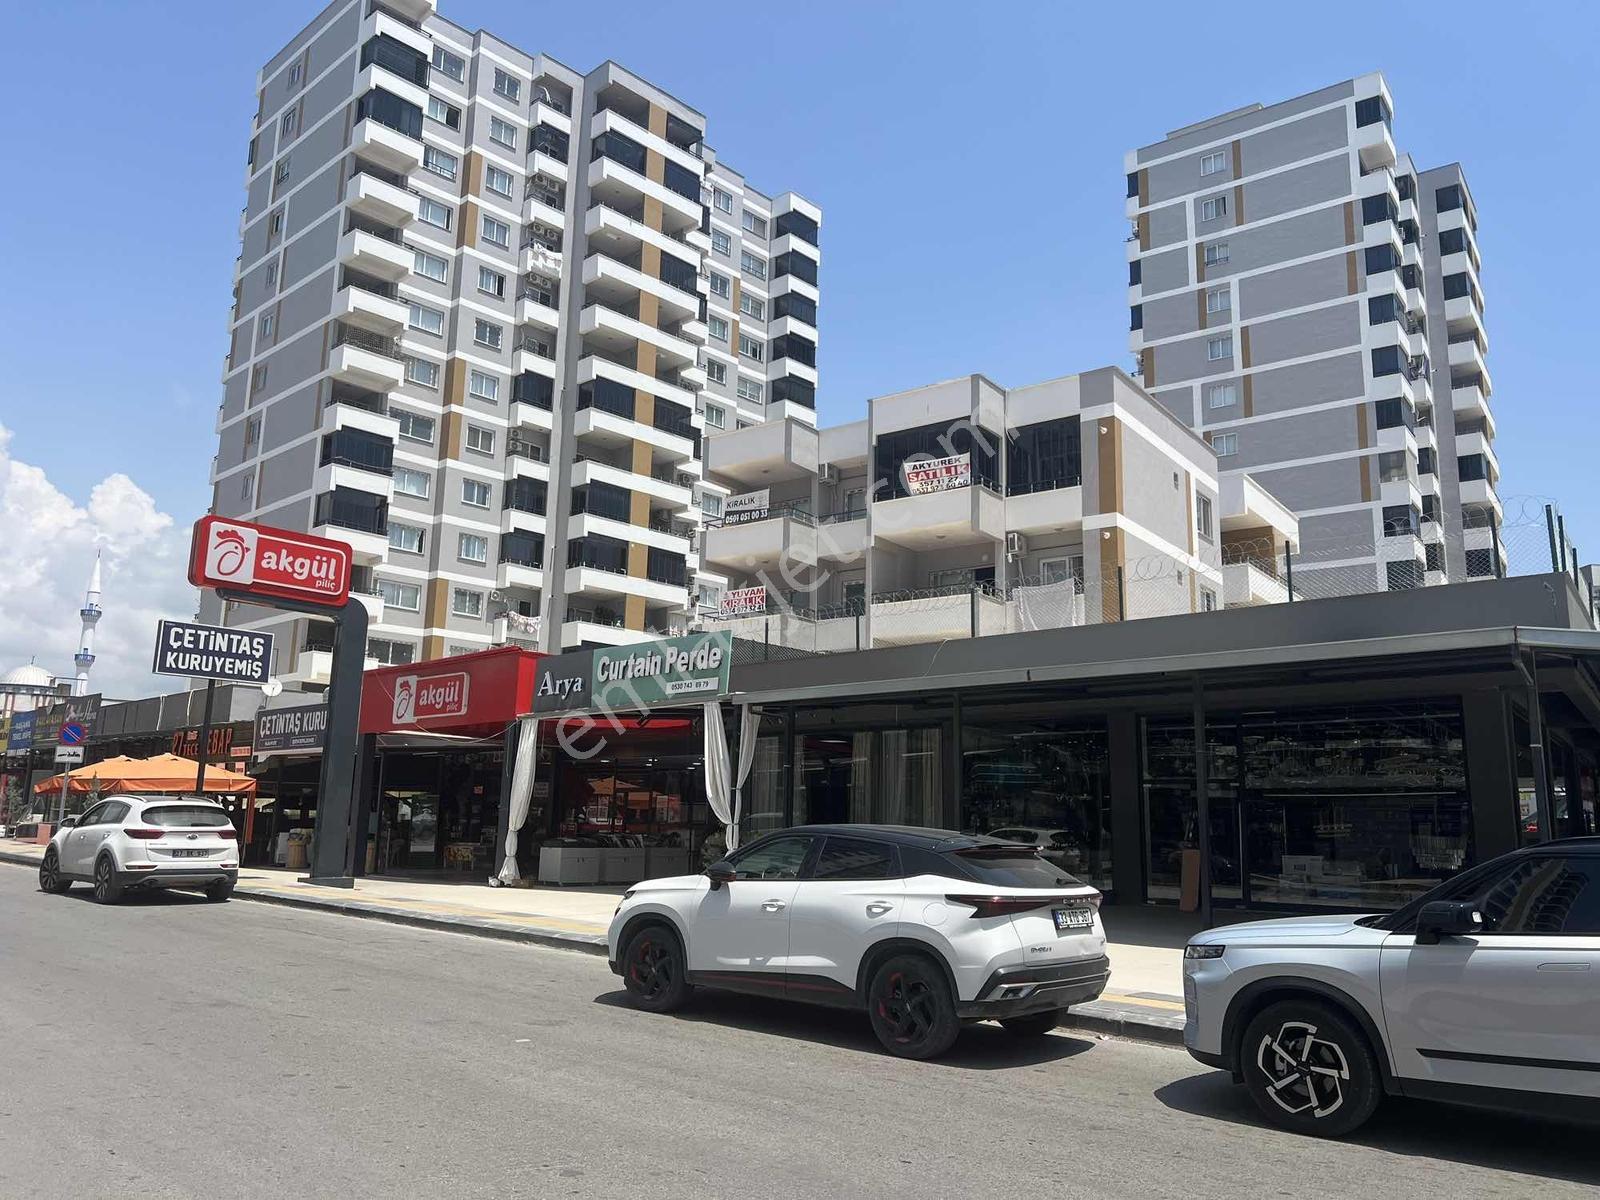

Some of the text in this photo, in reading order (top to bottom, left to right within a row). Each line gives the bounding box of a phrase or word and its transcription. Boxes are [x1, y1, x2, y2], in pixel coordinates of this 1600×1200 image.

[751, 510, 759, 519] 00
[760, 509, 768, 518] 33
[261, 549, 336, 580] akgül
[315, 578, 336, 591] piliç
[731, 587, 765, 598] YUVAM
[169, 627, 265, 658] ÇETİNTAŞ
[166, 652, 263, 679] KURUYEMİŞ
[597, 642, 722, 683] Curtain Perde
[419, 681, 460, 709] akgül
[537, 670, 583, 699] Arya
[260, 712, 301, 738] ÇETİNTAŞ
[207, 728, 233, 755] EBAP
